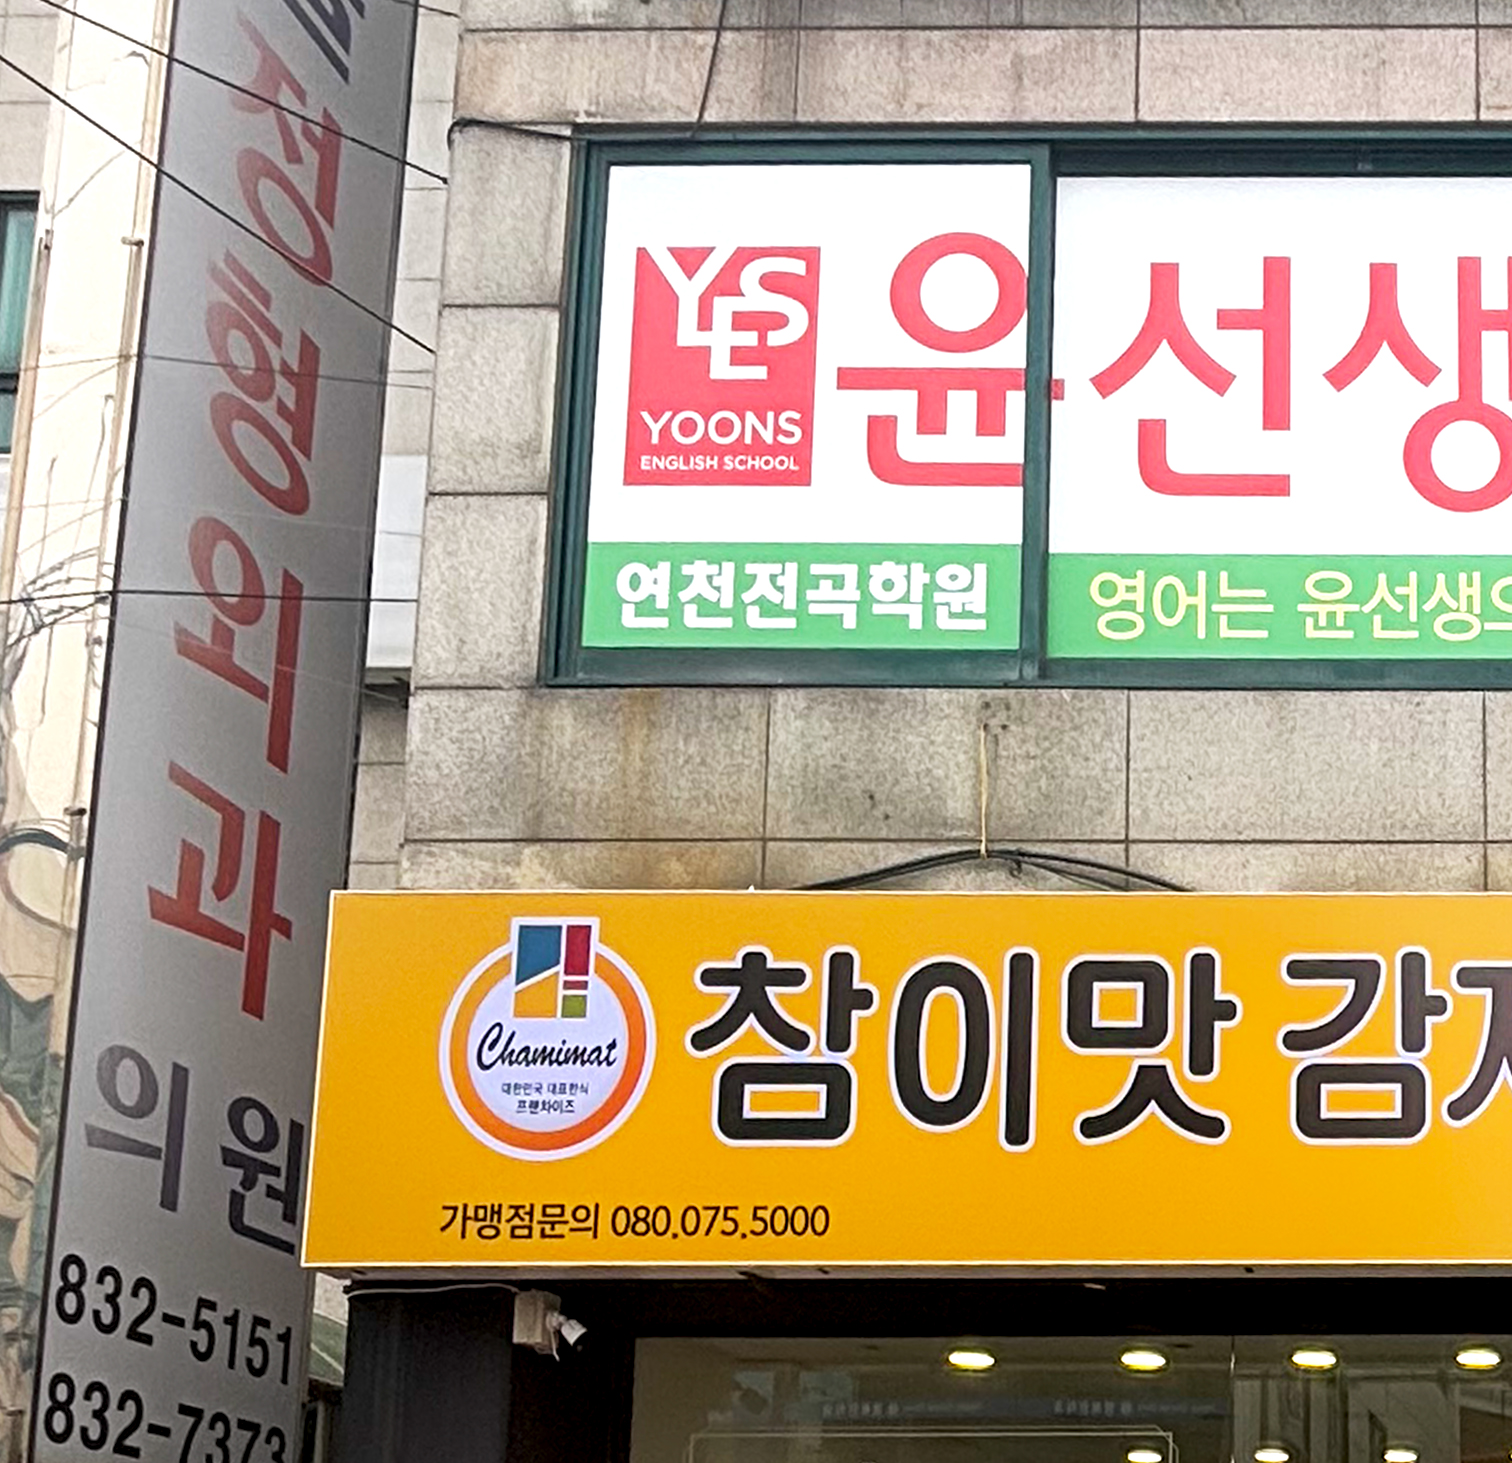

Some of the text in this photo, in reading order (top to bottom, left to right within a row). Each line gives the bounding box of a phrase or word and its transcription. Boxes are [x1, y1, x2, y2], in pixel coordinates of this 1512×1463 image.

[644, 246, 811, 381] YES
[640, 409, 803, 446] YOONS
[640, 454, 801, 471] ENGLISH SCHOOL
[147, 10, 343, 1021] 정형외과
[615, 560, 988, 631] 연천전곡학원
[1089, 569, 1275, 641] 영어는
[477, 1022, 618, 1071] Chamimat
[688, 948, 1239, 1150] 참이맛
[501, 1082, 590, 1097] 대한민국 대표한식
[84, 1044, 306, 1256] 의원
[439, 1203, 831, 1241] 가맹점문의 080.075.5000
[54, 1253, 293, 1386] 832-5151
